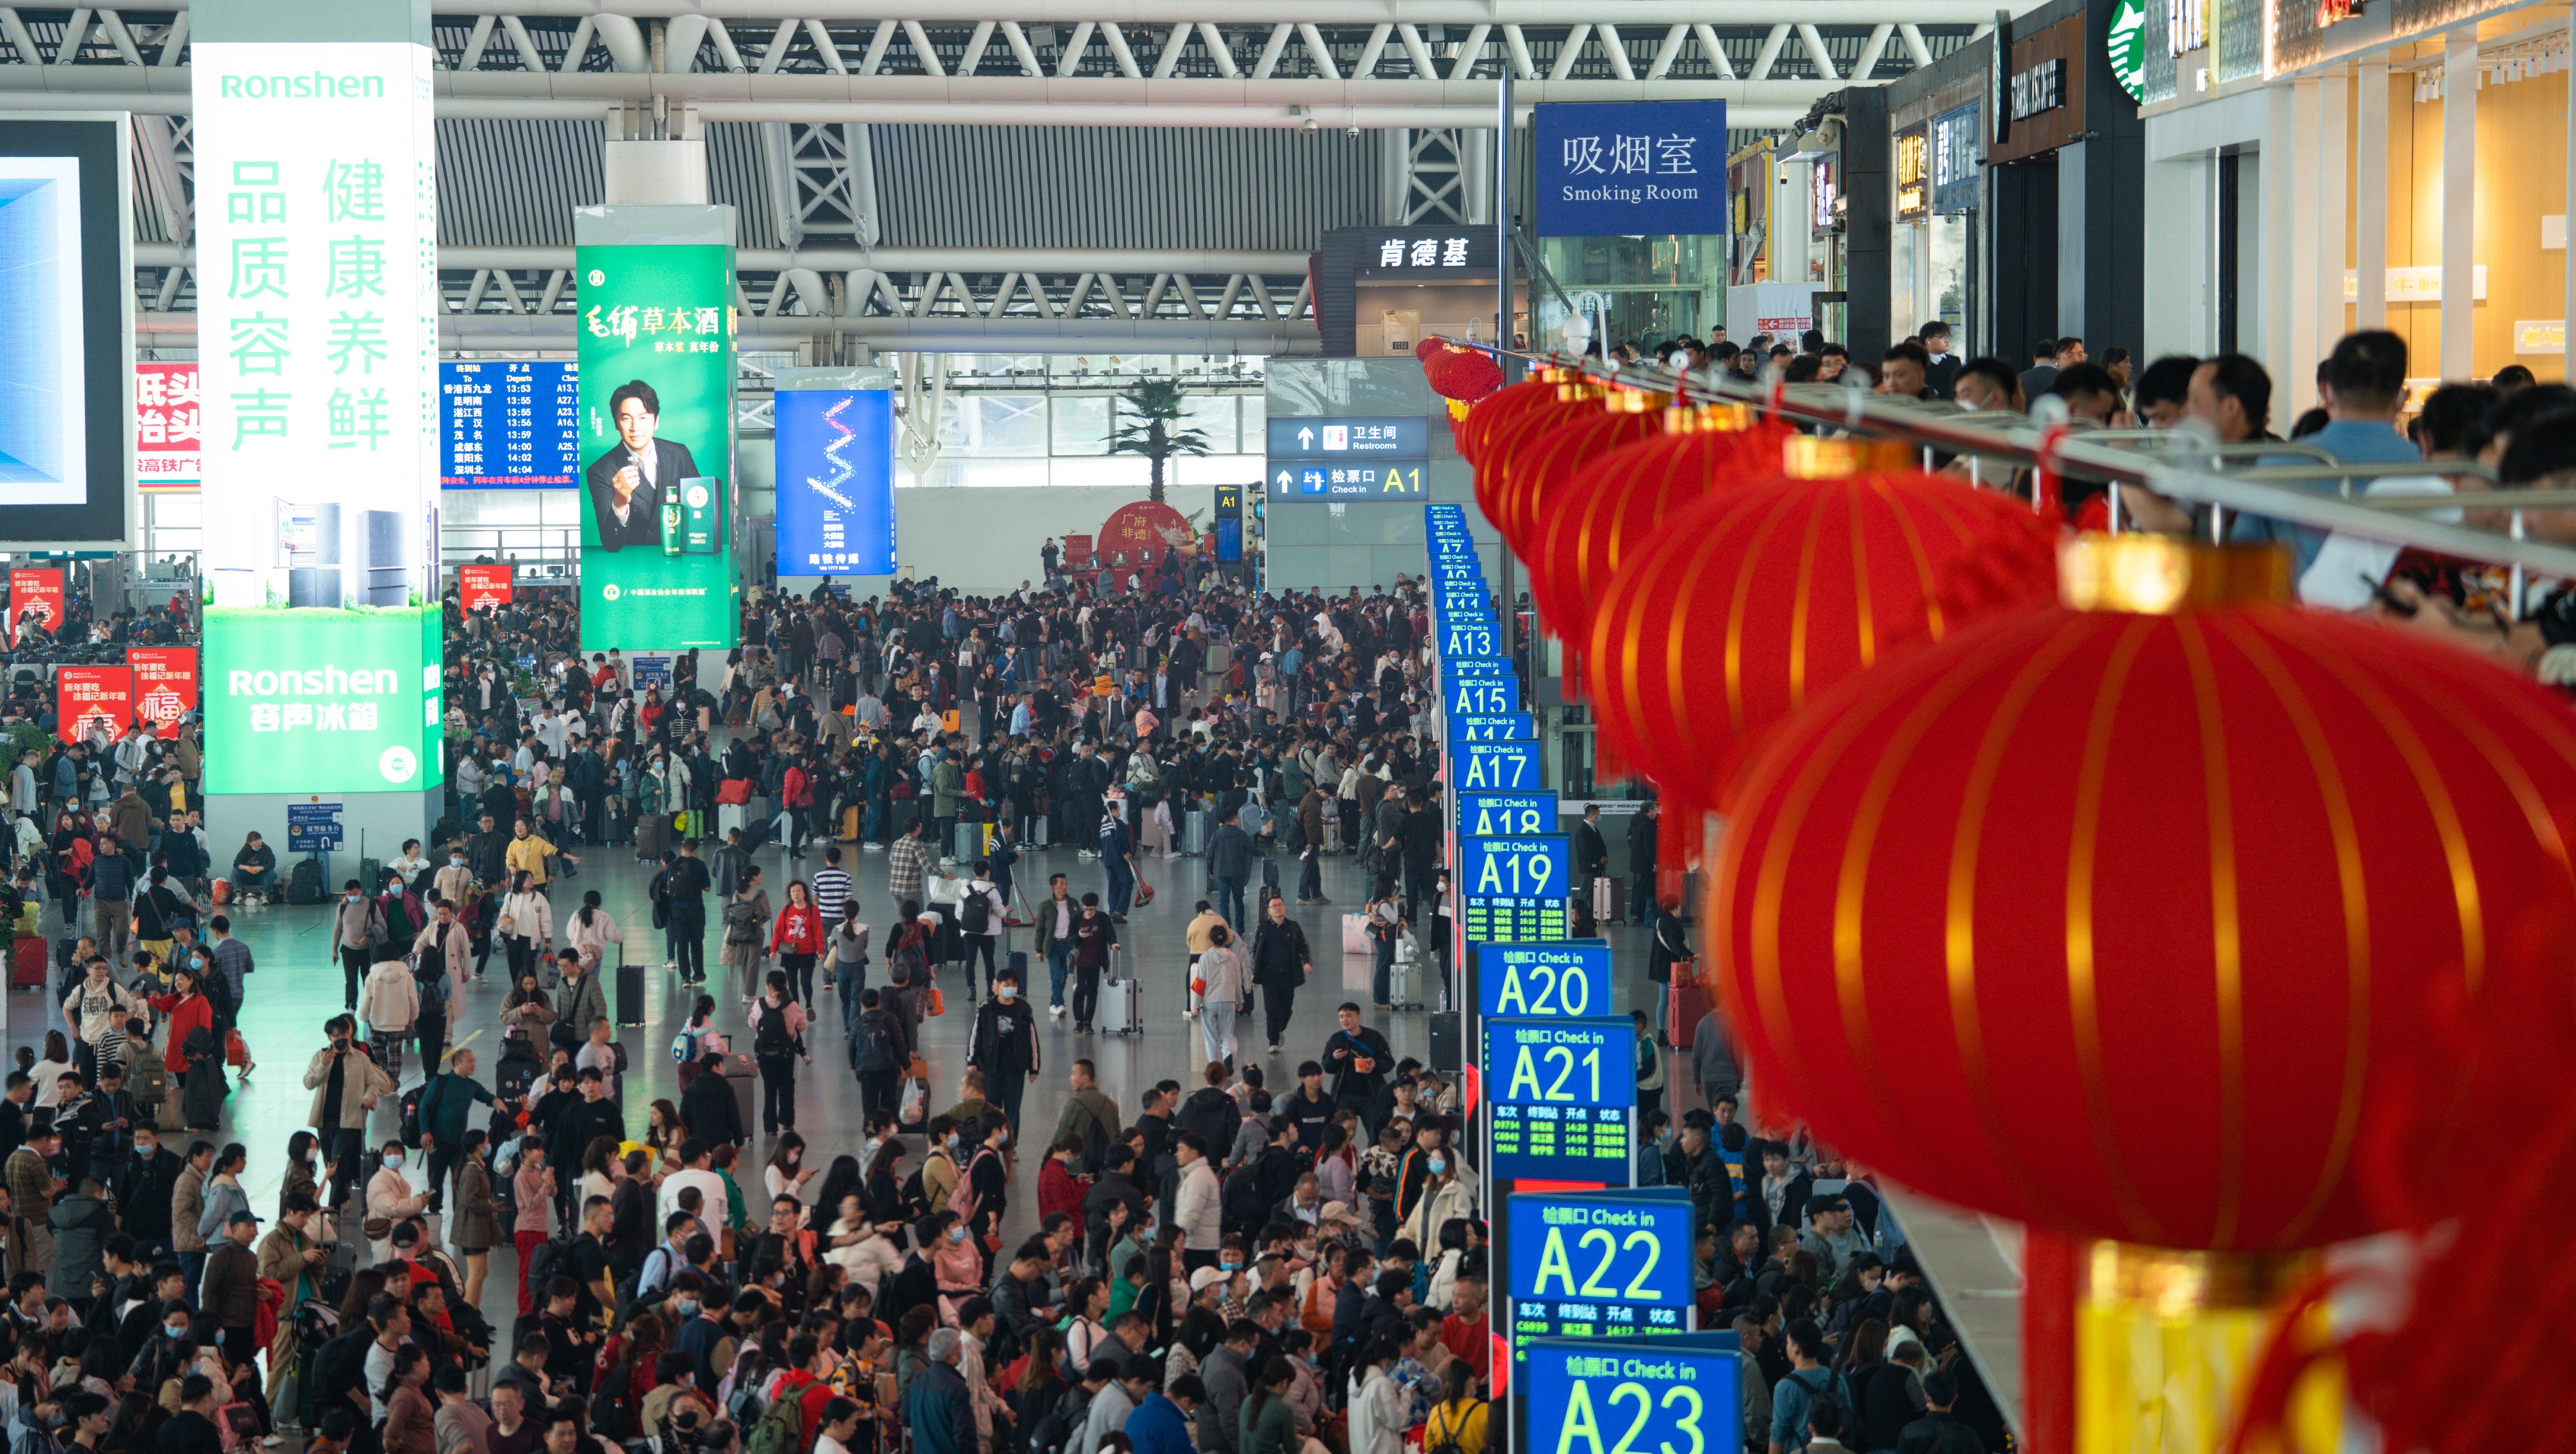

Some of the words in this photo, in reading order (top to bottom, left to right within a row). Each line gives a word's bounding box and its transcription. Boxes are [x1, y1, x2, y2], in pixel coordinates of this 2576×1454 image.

[221, 71, 383, 98] Ronshen
[1563, 133, 1698, 176] 吸烟室
[1563, 184, 1641, 205] Smoking
[1646, 184, 1699, 200] Room
[1381, 238, 1469, 267] 肯德基
[227, 160, 292, 453] 品质容声
[322, 157, 390, 452] 健康养鲜
[585, 305, 719, 348] 毛铺草本酒
[689, 342, 719, 353] 真年份
[136, 372, 199, 407] 低头
[444, 384, 491, 394] 香港西九龙
[454, 396, 481, 405] 昆明南
[454, 408, 481, 417] 湛江西
[137, 409, 199, 443] 抬头
[454, 419, 482, 428] 武汉
[1353, 426, 1396, 439] 卫生间
[455, 431, 482, 440] 茂名
[455, 443, 482, 451] 成都东
[455, 466, 484, 474] 深圳北
[1331, 469, 1375, 483] 检票口
[1383, 469, 1419, 492] A1
[1222, 496, 1235, 507] A1
[1122, 513, 1146, 527] 广府
[1122, 527, 1146, 540] 非遗
[1448, 632, 1490, 654] A13
[135, 664, 166, 672] 新年要吃
[141, 671, 191, 680] 徐福记新年糖
[64, 682, 101, 692] 新年要吃
[229, 664, 398, 695] Ronshen
[73, 691, 127, 701] 徐福记新年糖
[144, 691, 181, 720] 福
[1456, 688, 1505, 713] A15
[250, 702, 379, 732] 容声冰箱
[1470, 745, 1492, 754] 检票口
[1466, 755, 1526, 787] A17
[1478, 799, 1502, 808] 检票口
[1504, 799, 1528, 807] Check
[1476, 809, 1541, 834] A18
[1483, 843, 1509, 852] 检票口
[1511, 843, 1537, 852] Check
[1540, 843, 1548, 852] in
[1478, 854, 1551, 894] A19
[1492, 898, 1514, 907] 终到站
[1545, 899, 1559, 908] 状态
[1504, 951, 1535, 964] 检票口
[1538, 951, 1569, 964] Check
[1574, 953, 1582, 964] in
[1497, 965, 1588, 1016] A20
[1516, 1029, 1551, 1043] 检票口
[1554, 1030, 1589, 1044] Check
[1593, 1032, 1603, 1044] in
[1508, 1045, 1599, 1102] A21
[1498, 1106, 1517, 1117] 车次
[1528, 1106, 1557, 1118] 终到站
[1566, 1108, 1585, 1118] 开点
[1600, 1109, 1619, 1121] 状态
[1543, 1207, 1588, 1224] 检票口
[1592, 1209, 1637, 1226] Check
[1641, 1211, 1654, 1227] in
[1533, 1227, 1662, 1300] A22
[1521, 1304, 1544, 1316] 车次
[1559, 1304, 1596, 1319] 终到站
[1608, 1306, 1631, 1319] 开点
[1650, 1309, 1674, 1323] 状态
[1566, 1356, 1619, 1377] 检票口
[1623, 1360, 1675, 1379] Check
[1680, 1363, 1696, 1380] in
[1556, 1379, 1704, 1454] A23
